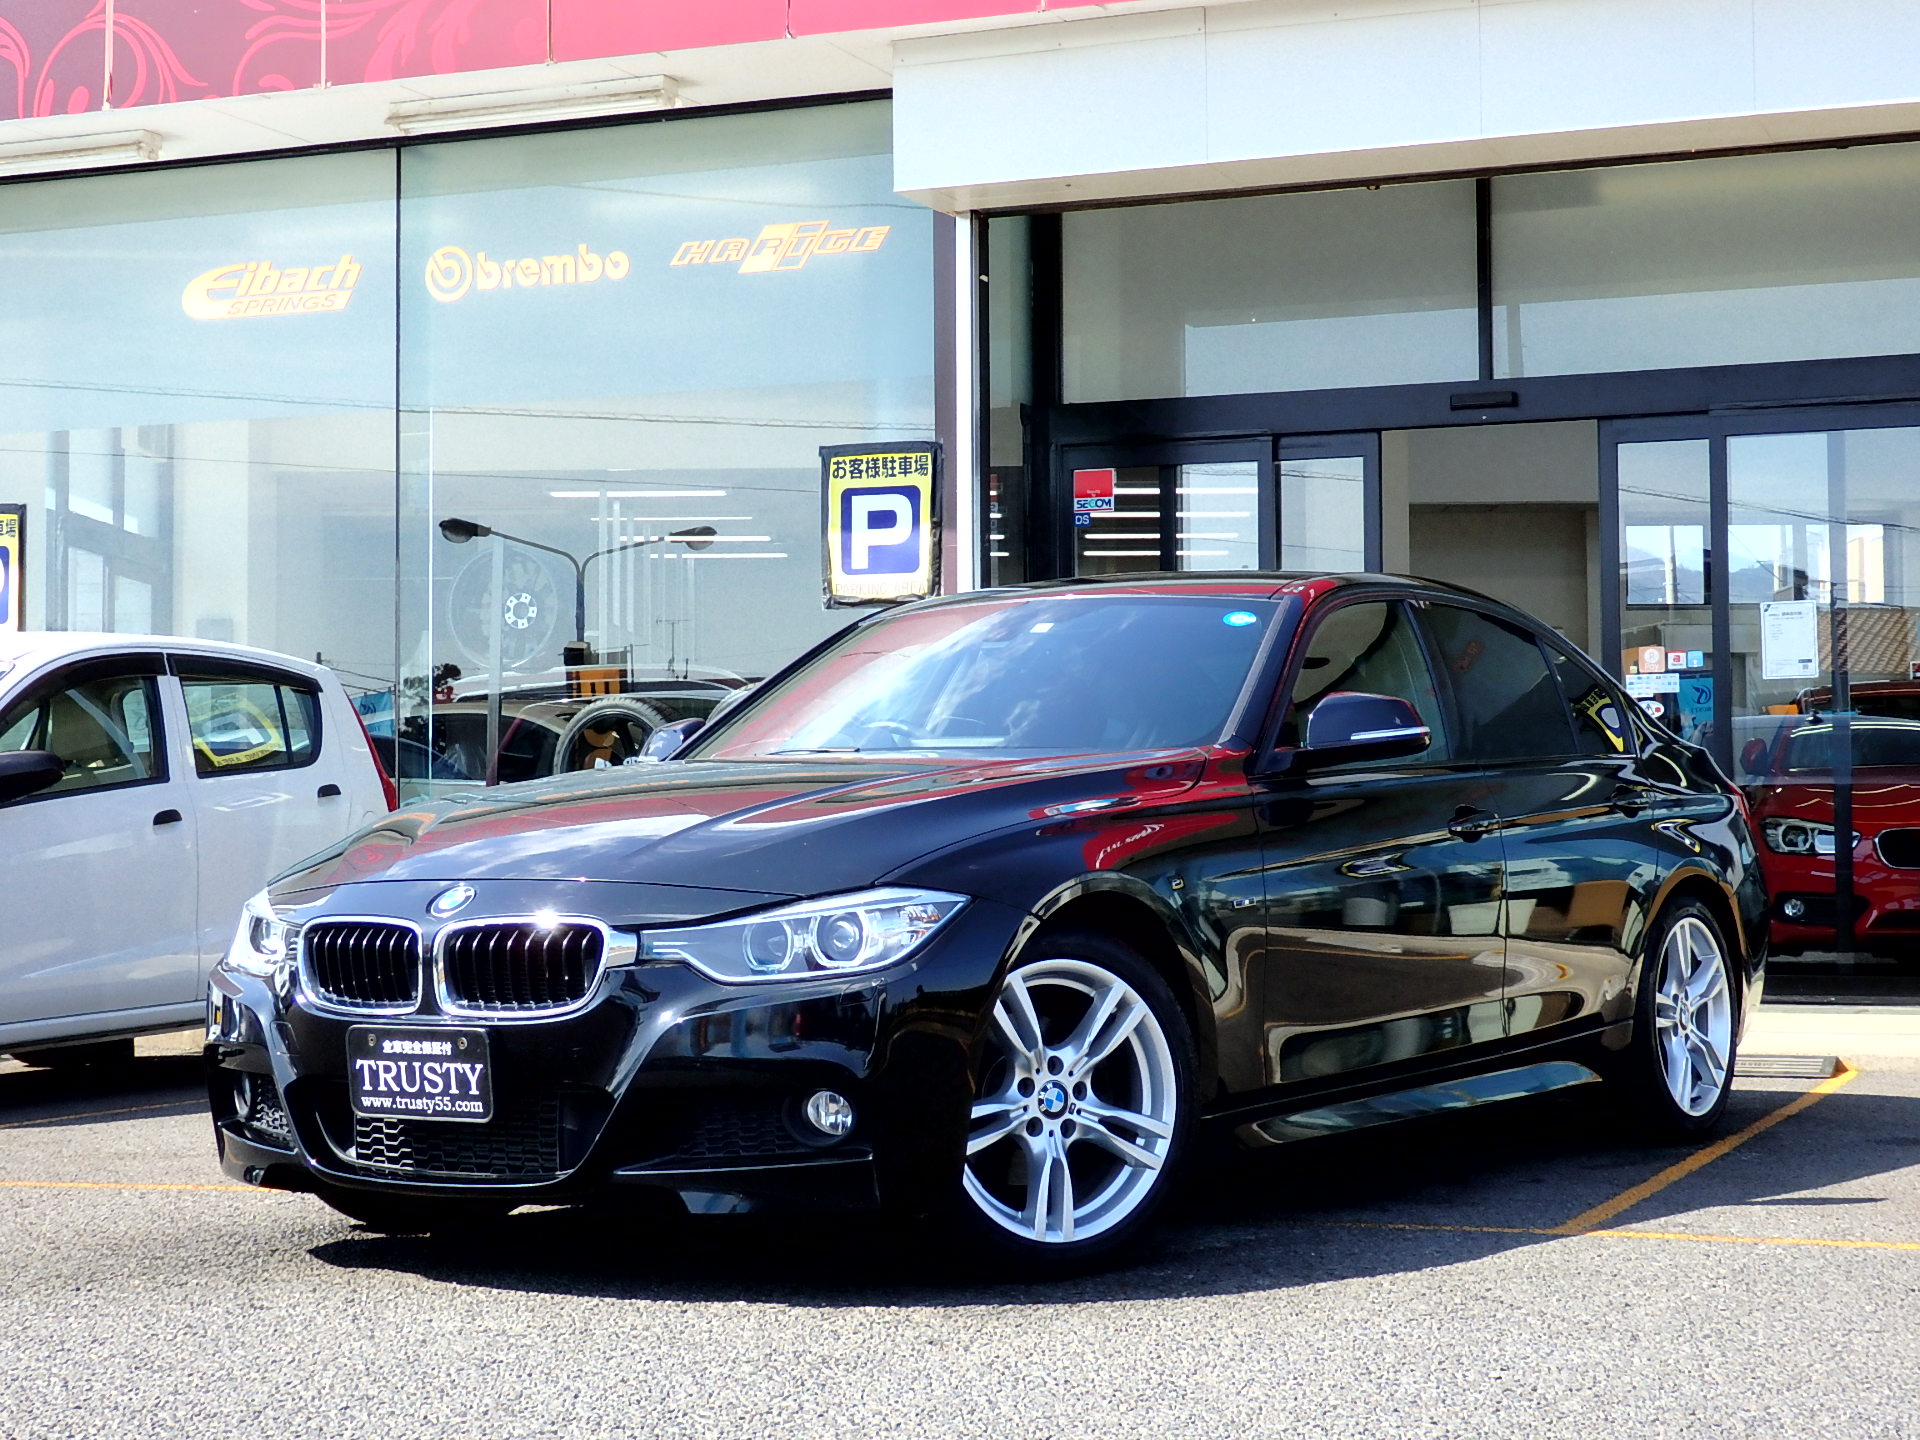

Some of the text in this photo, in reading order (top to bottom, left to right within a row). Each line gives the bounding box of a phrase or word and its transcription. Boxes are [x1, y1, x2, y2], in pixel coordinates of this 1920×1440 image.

[476, 243, 630, 291] brembo
[182, 254, 363, 320] Eibach
[228, 293, 338, 316] SPRINGS
[832, 454, 929, 480] お客様駐車場
[1076, 498, 1112, 509] SECOM
[851, 493, 913, 570] P
[1075, 514, 1090, 525] DS
[355, 1058, 484, 1095] TRUSTY
[360, 1095, 484, 1114] www.trusty55.com
